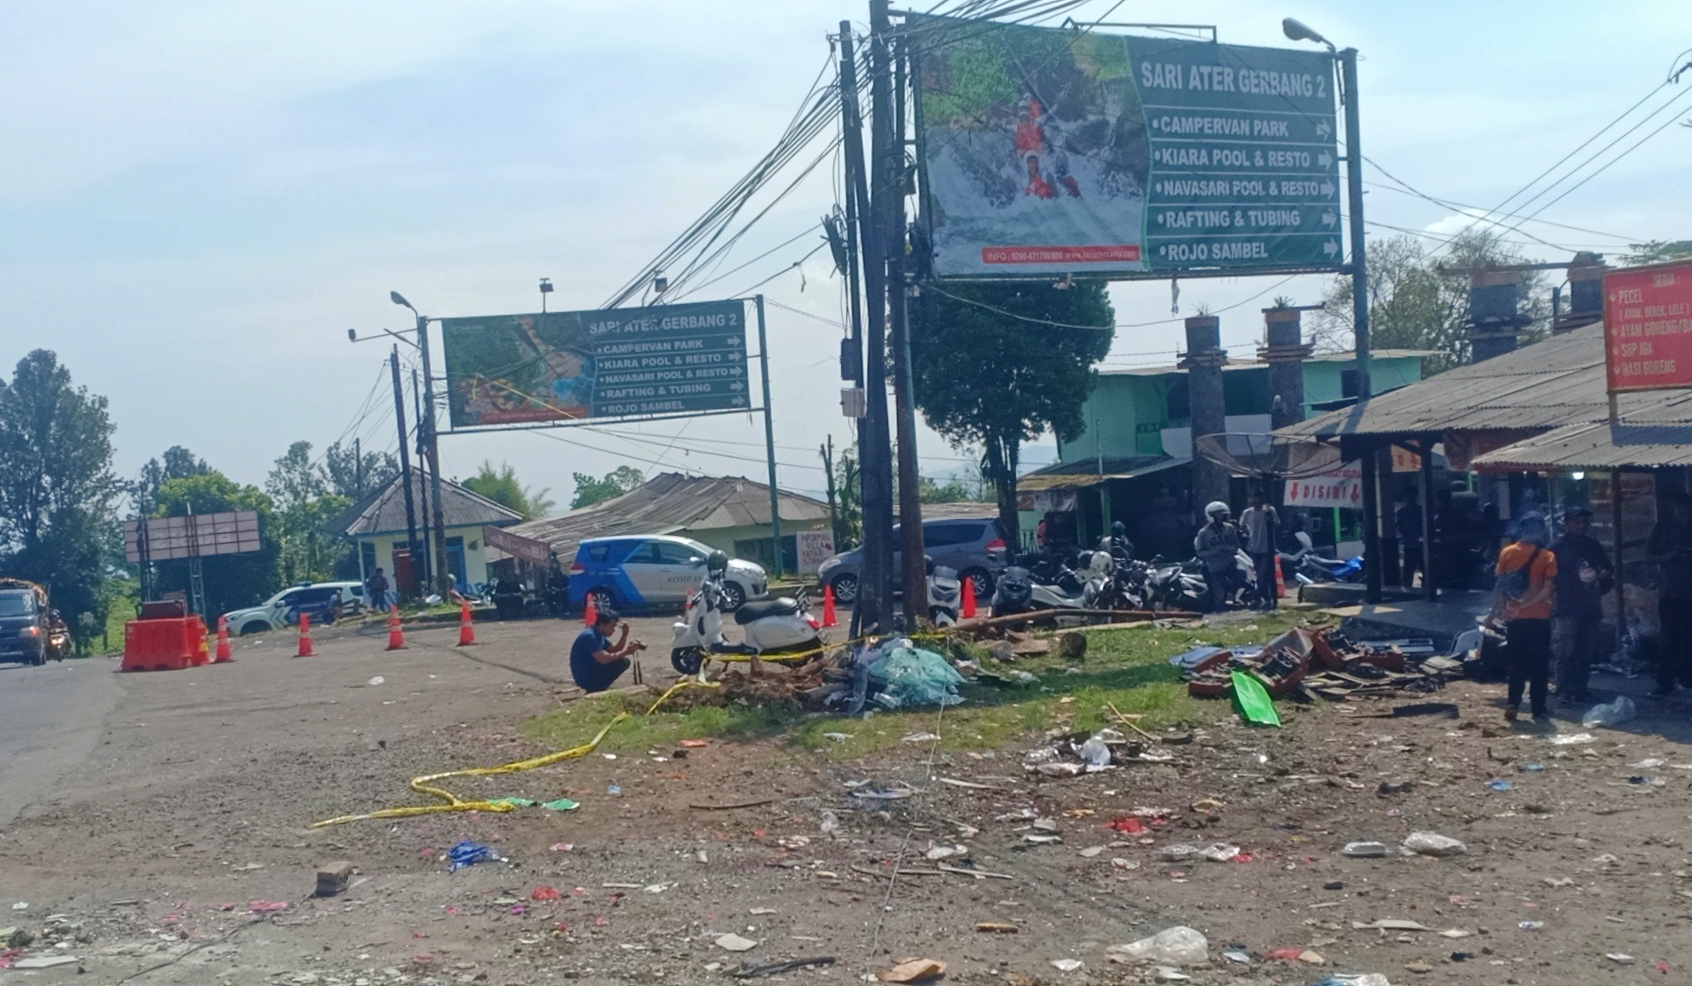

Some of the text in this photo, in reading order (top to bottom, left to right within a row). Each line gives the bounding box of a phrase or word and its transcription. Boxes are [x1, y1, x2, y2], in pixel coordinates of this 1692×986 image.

[1142, 62, 1326, 98] SARI ATER GERBANG 2
[1161, 116, 1289, 137] CAMPERVAN PARK
[1162, 148, 1310, 167] KIARA POOL & RESTO
[1164, 180, 1319, 196] NAVASARI POOL & RESTO
[1166, 210, 1300, 228] RAFTING & TUBING
[988, 252, 1006, 260] INFO
[1168, 242, 1268, 261] ROJO SAMBEL
[1618, 289, 1643, 304] PECEL
[662, 314, 725, 330] GERBANG
[729, 313, 737, 326] 2
[1621, 323, 1642, 338] AYAM
[604, 340, 703, 354] CAMPERVAN PARK
[1621, 342, 1653, 357] SOP IGA
[604, 354, 721, 369] KIARA POOL & RESTO
[1622, 360, 1676, 376] NASI GORENG
[606, 368, 728, 383] NAVASARI POOL & RESTO
[606, 384, 711, 398] RAFTING & TUBING
[608, 401, 685, 414] ROJO SAMBEL
[1303, 484, 1346, 499] DISINI
